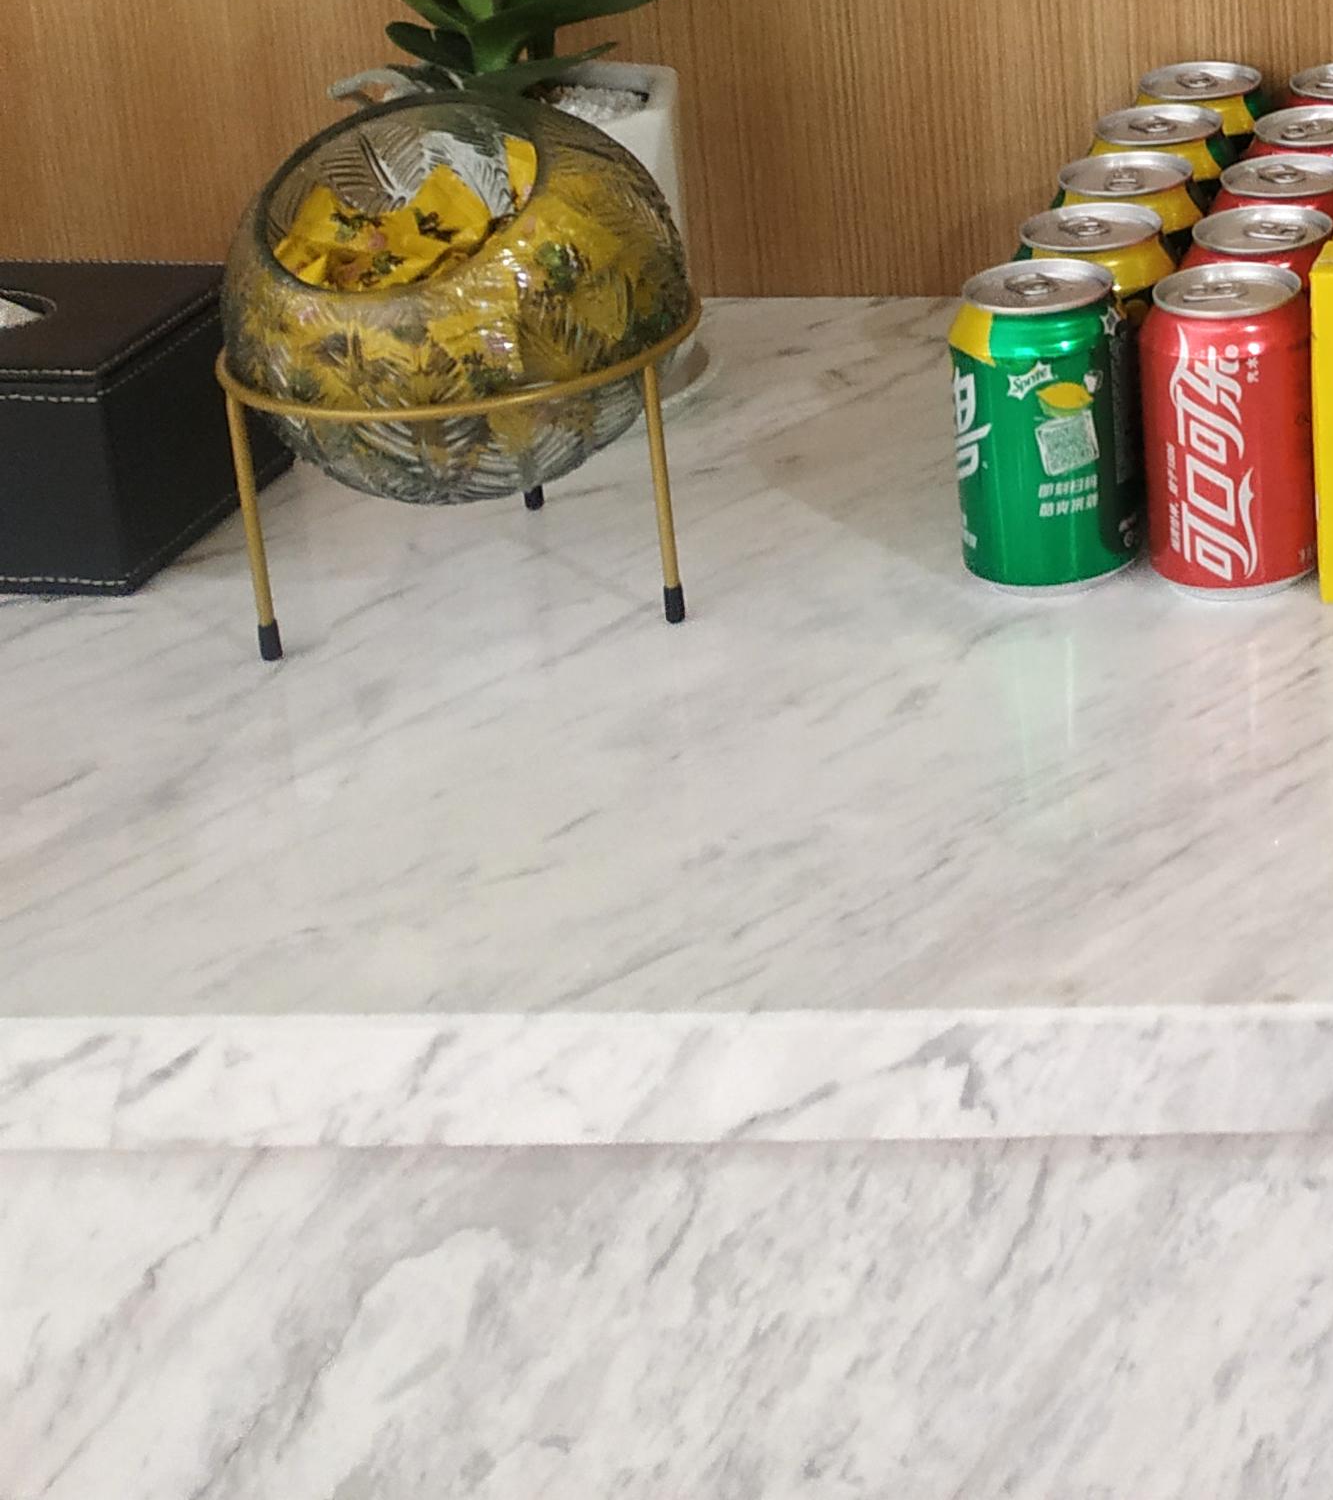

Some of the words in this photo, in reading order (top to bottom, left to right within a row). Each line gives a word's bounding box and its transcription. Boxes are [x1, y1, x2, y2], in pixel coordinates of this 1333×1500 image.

[1011, 364, 1049, 394] Sprite
[1169, 324, 1256, 581] 可口可乐
